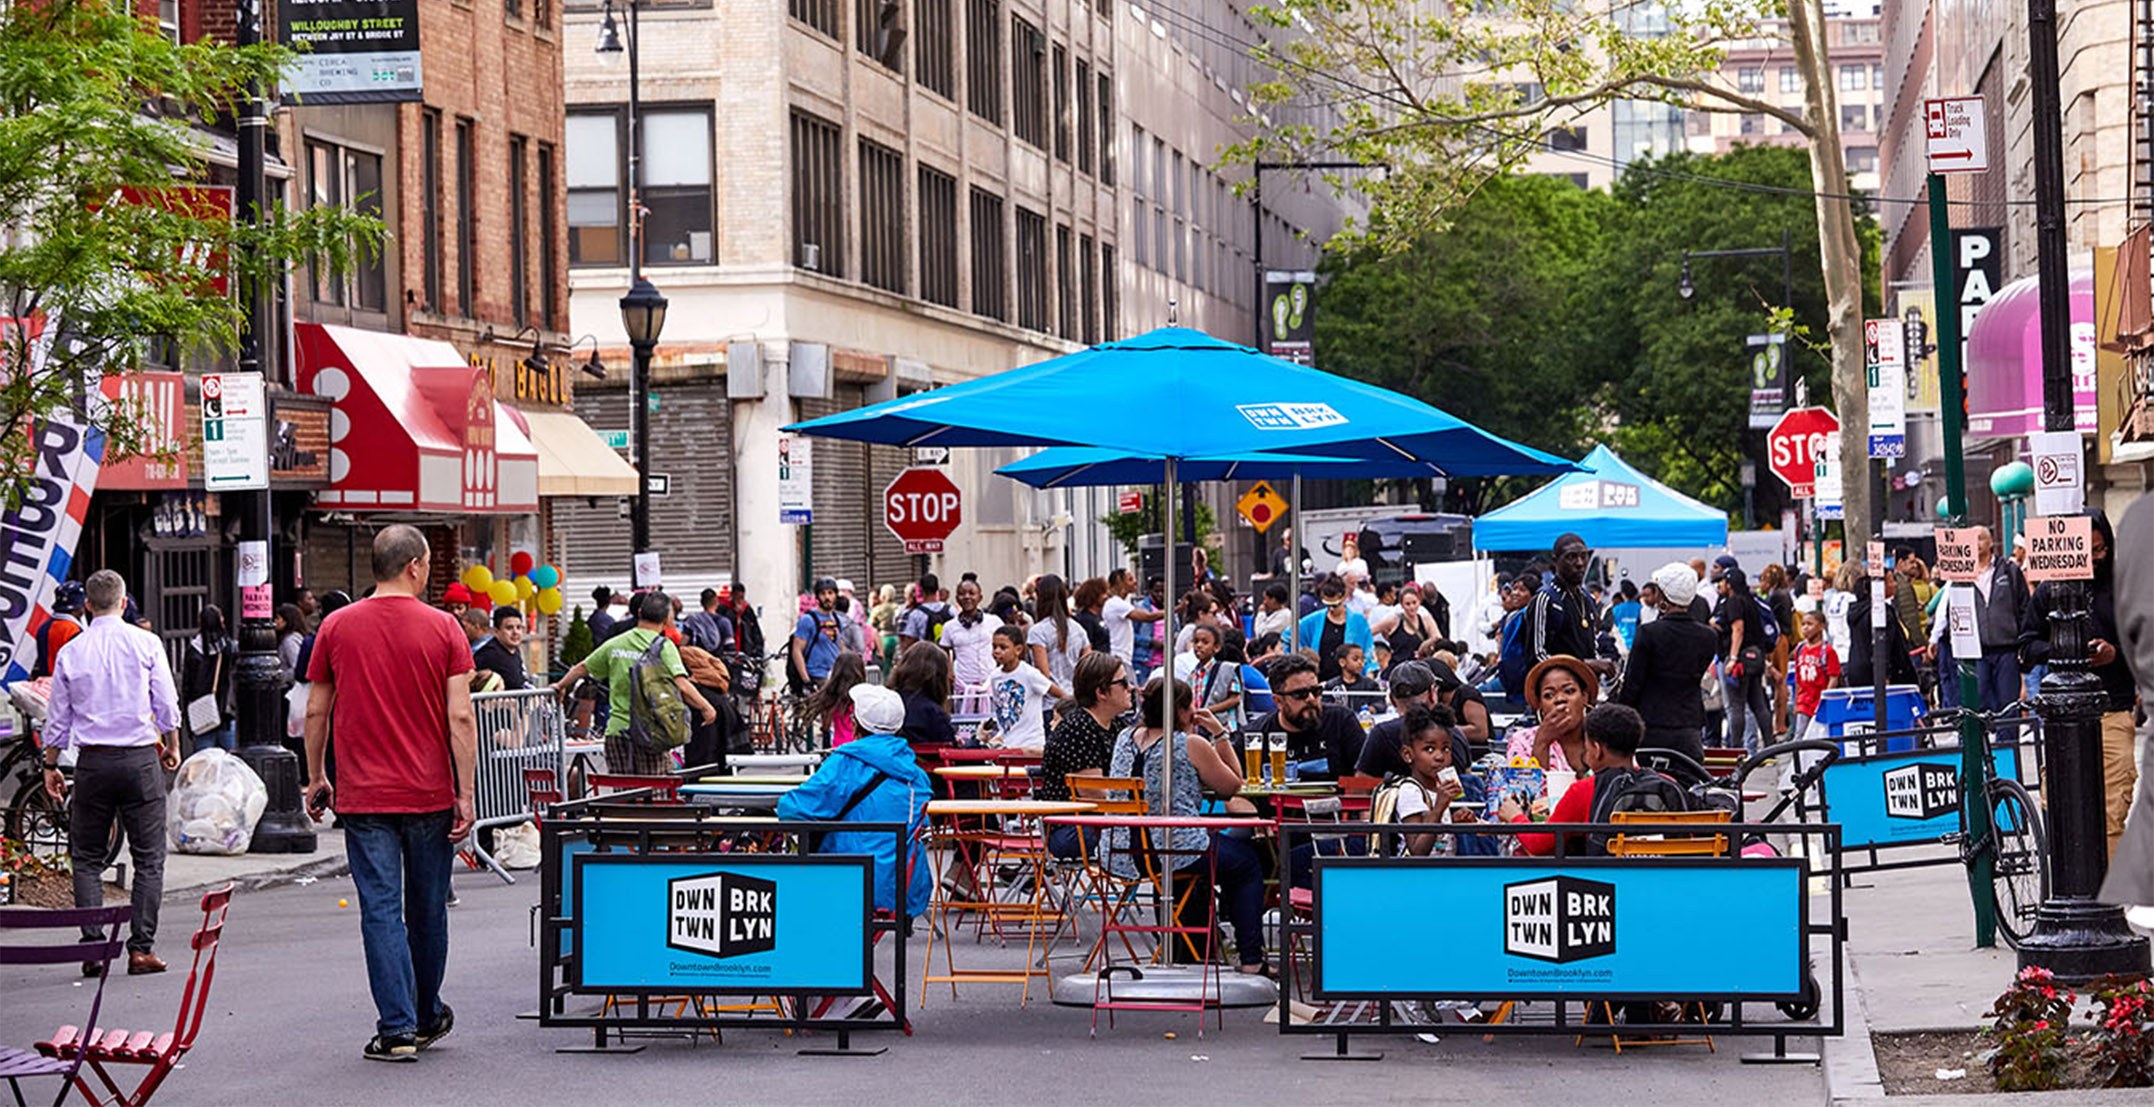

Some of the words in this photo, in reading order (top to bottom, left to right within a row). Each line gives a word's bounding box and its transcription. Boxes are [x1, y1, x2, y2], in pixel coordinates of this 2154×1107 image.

[290, 20, 358, 31] WILLOUGHBY
[361, 18, 404, 29] STREET
[290, 33, 328, 41] BETWEEN
[1946, 103, 1964, 114] Truck
[1947, 115, 1971, 127] Loading
[1949, 127, 1962, 140] Only
[889, 492, 959, 523] STOP
[2048, 520, 2066, 534] NO
[1943, 530, 1955, 543] NO
[2032, 536, 2084, 552] PARKING
[2028, 553, 2089, 570] WEDNESDAY
[1888, 773, 1916, 791] DWN
[1925, 771, 1956, 789] BRK
[1890, 793, 1918, 809] TWN
[1927, 789, 1958, 809] LYN
[675, 887, 715, 911] DWN
[730, 887, 773, 913] BRK
[1511, 892, 1552, 916] DWN
[1567, 892, 1611, 917] BRK
[675, 915, 715, 941] TWN
[729, 918, 773, 942] LYN
[1511, 922, 1552, 946] TWN
[1567, 922, 1612, 947] LYN
[669, 961, 772, 974] DowntownBrooklyn.com
[1507, 968, 1613, 978] DowntownBrooklyn.com
